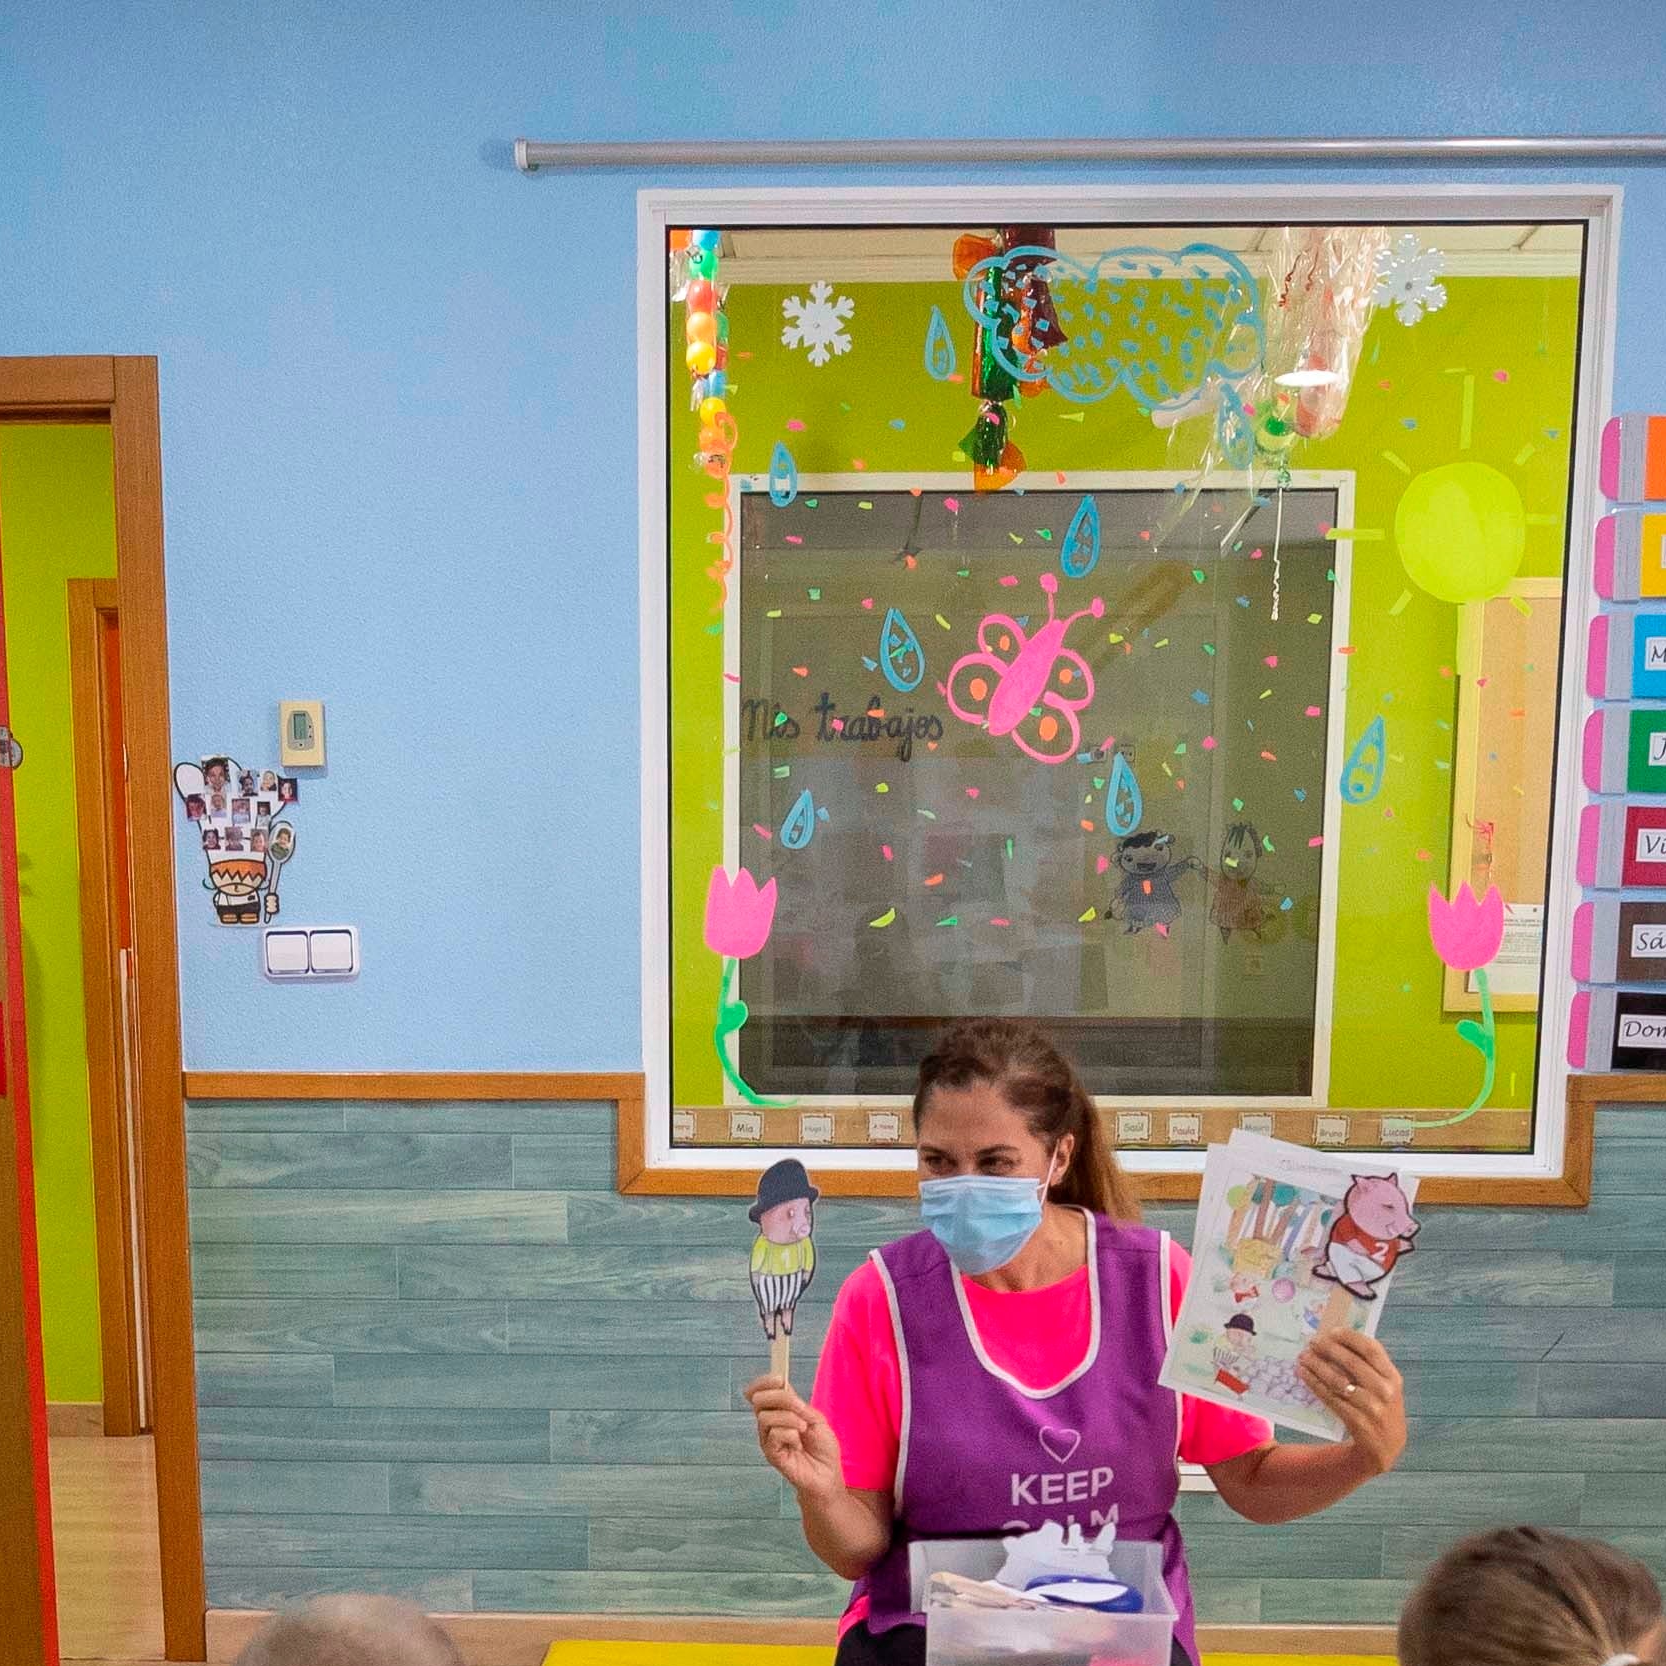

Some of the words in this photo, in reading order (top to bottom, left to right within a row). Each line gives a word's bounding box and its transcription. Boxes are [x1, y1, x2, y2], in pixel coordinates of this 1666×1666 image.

[814, 691, 944, 762] trabajos
[1371, 1241, 1390, 1263] 2
[1011, 1466, 1115, 1507] KEEP
